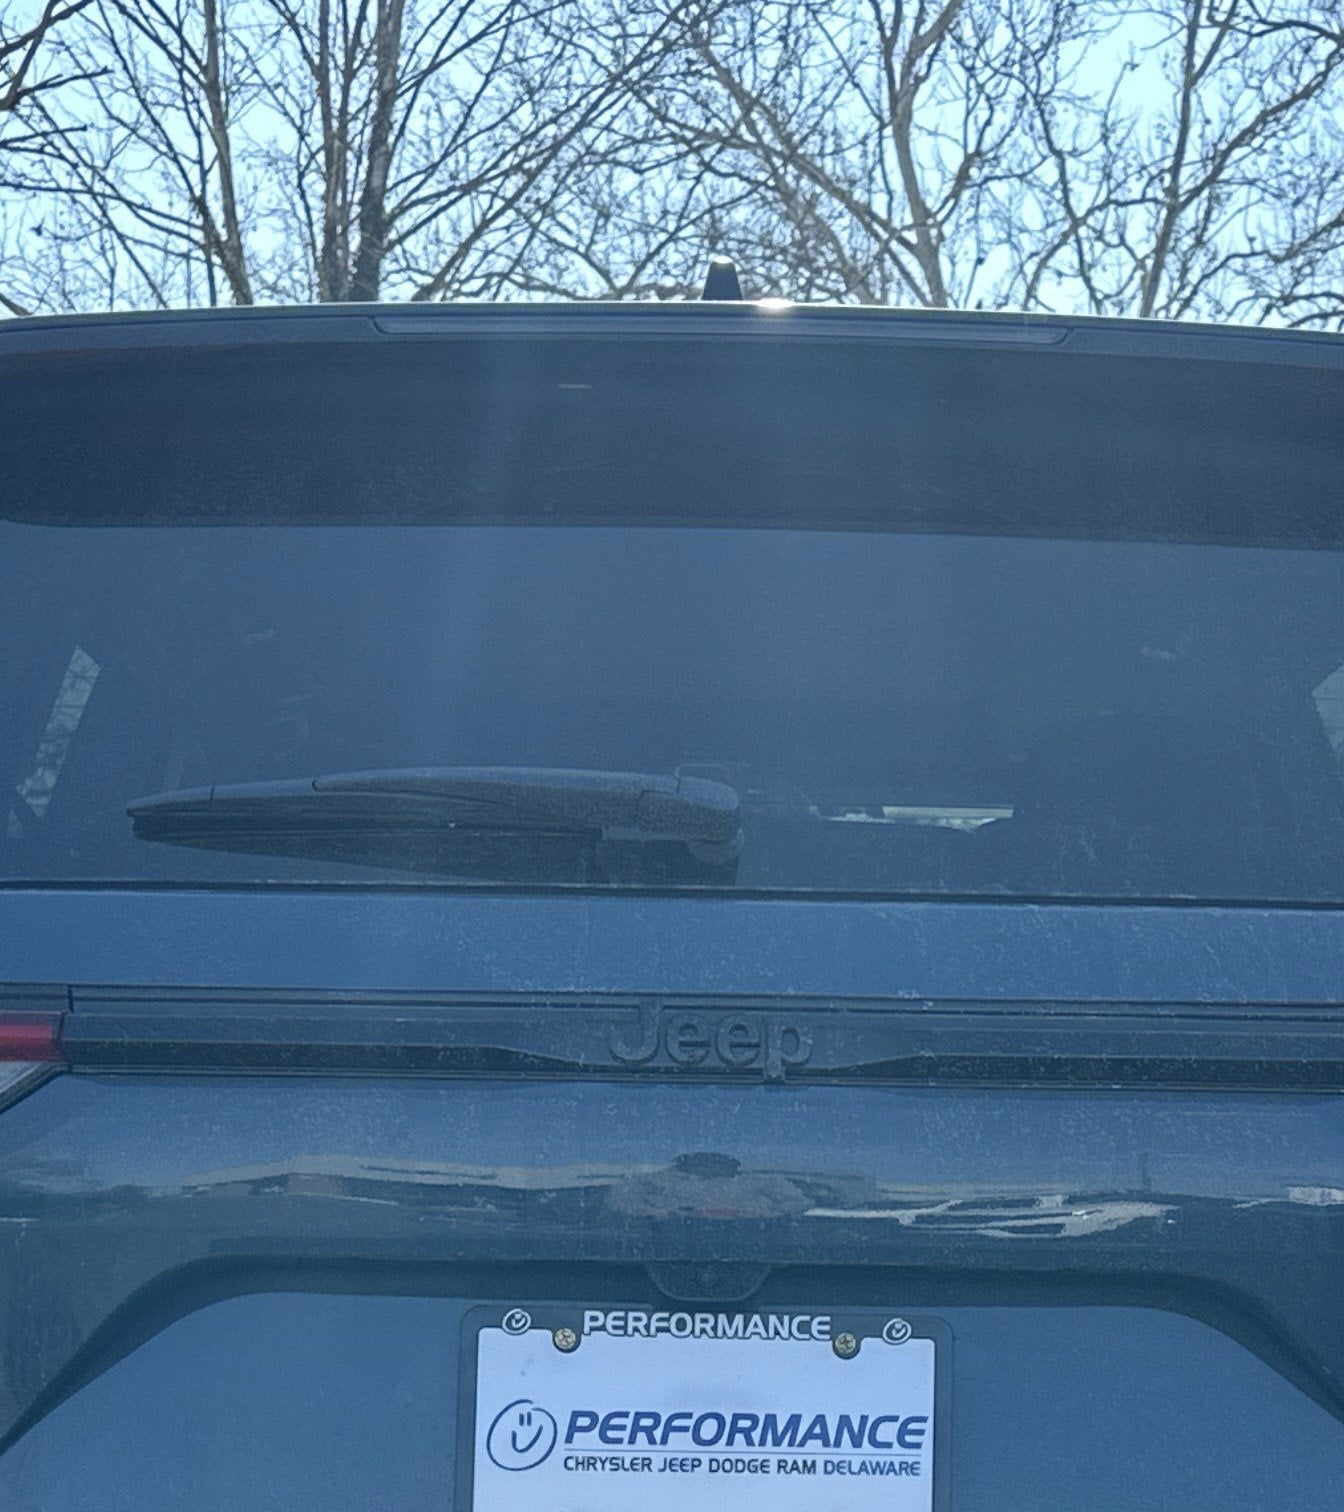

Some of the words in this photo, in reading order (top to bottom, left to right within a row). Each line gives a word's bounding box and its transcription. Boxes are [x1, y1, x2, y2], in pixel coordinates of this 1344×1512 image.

[607, 1000, 812, 1084] Jeep
[582, 1309, 832, 1342] PERFORMANCE
[563, 1410, 929, 1450] PERFORMANCE
[563, 1455, 653, 1473] CHRYSLER
[657, 1456, 702, 1474] JEEP
[708, 1458, 771, 1475] DODGE
[776, 1459, 817, 1476] RAM
[823, 1459, 921, 1478] DELAWARE
